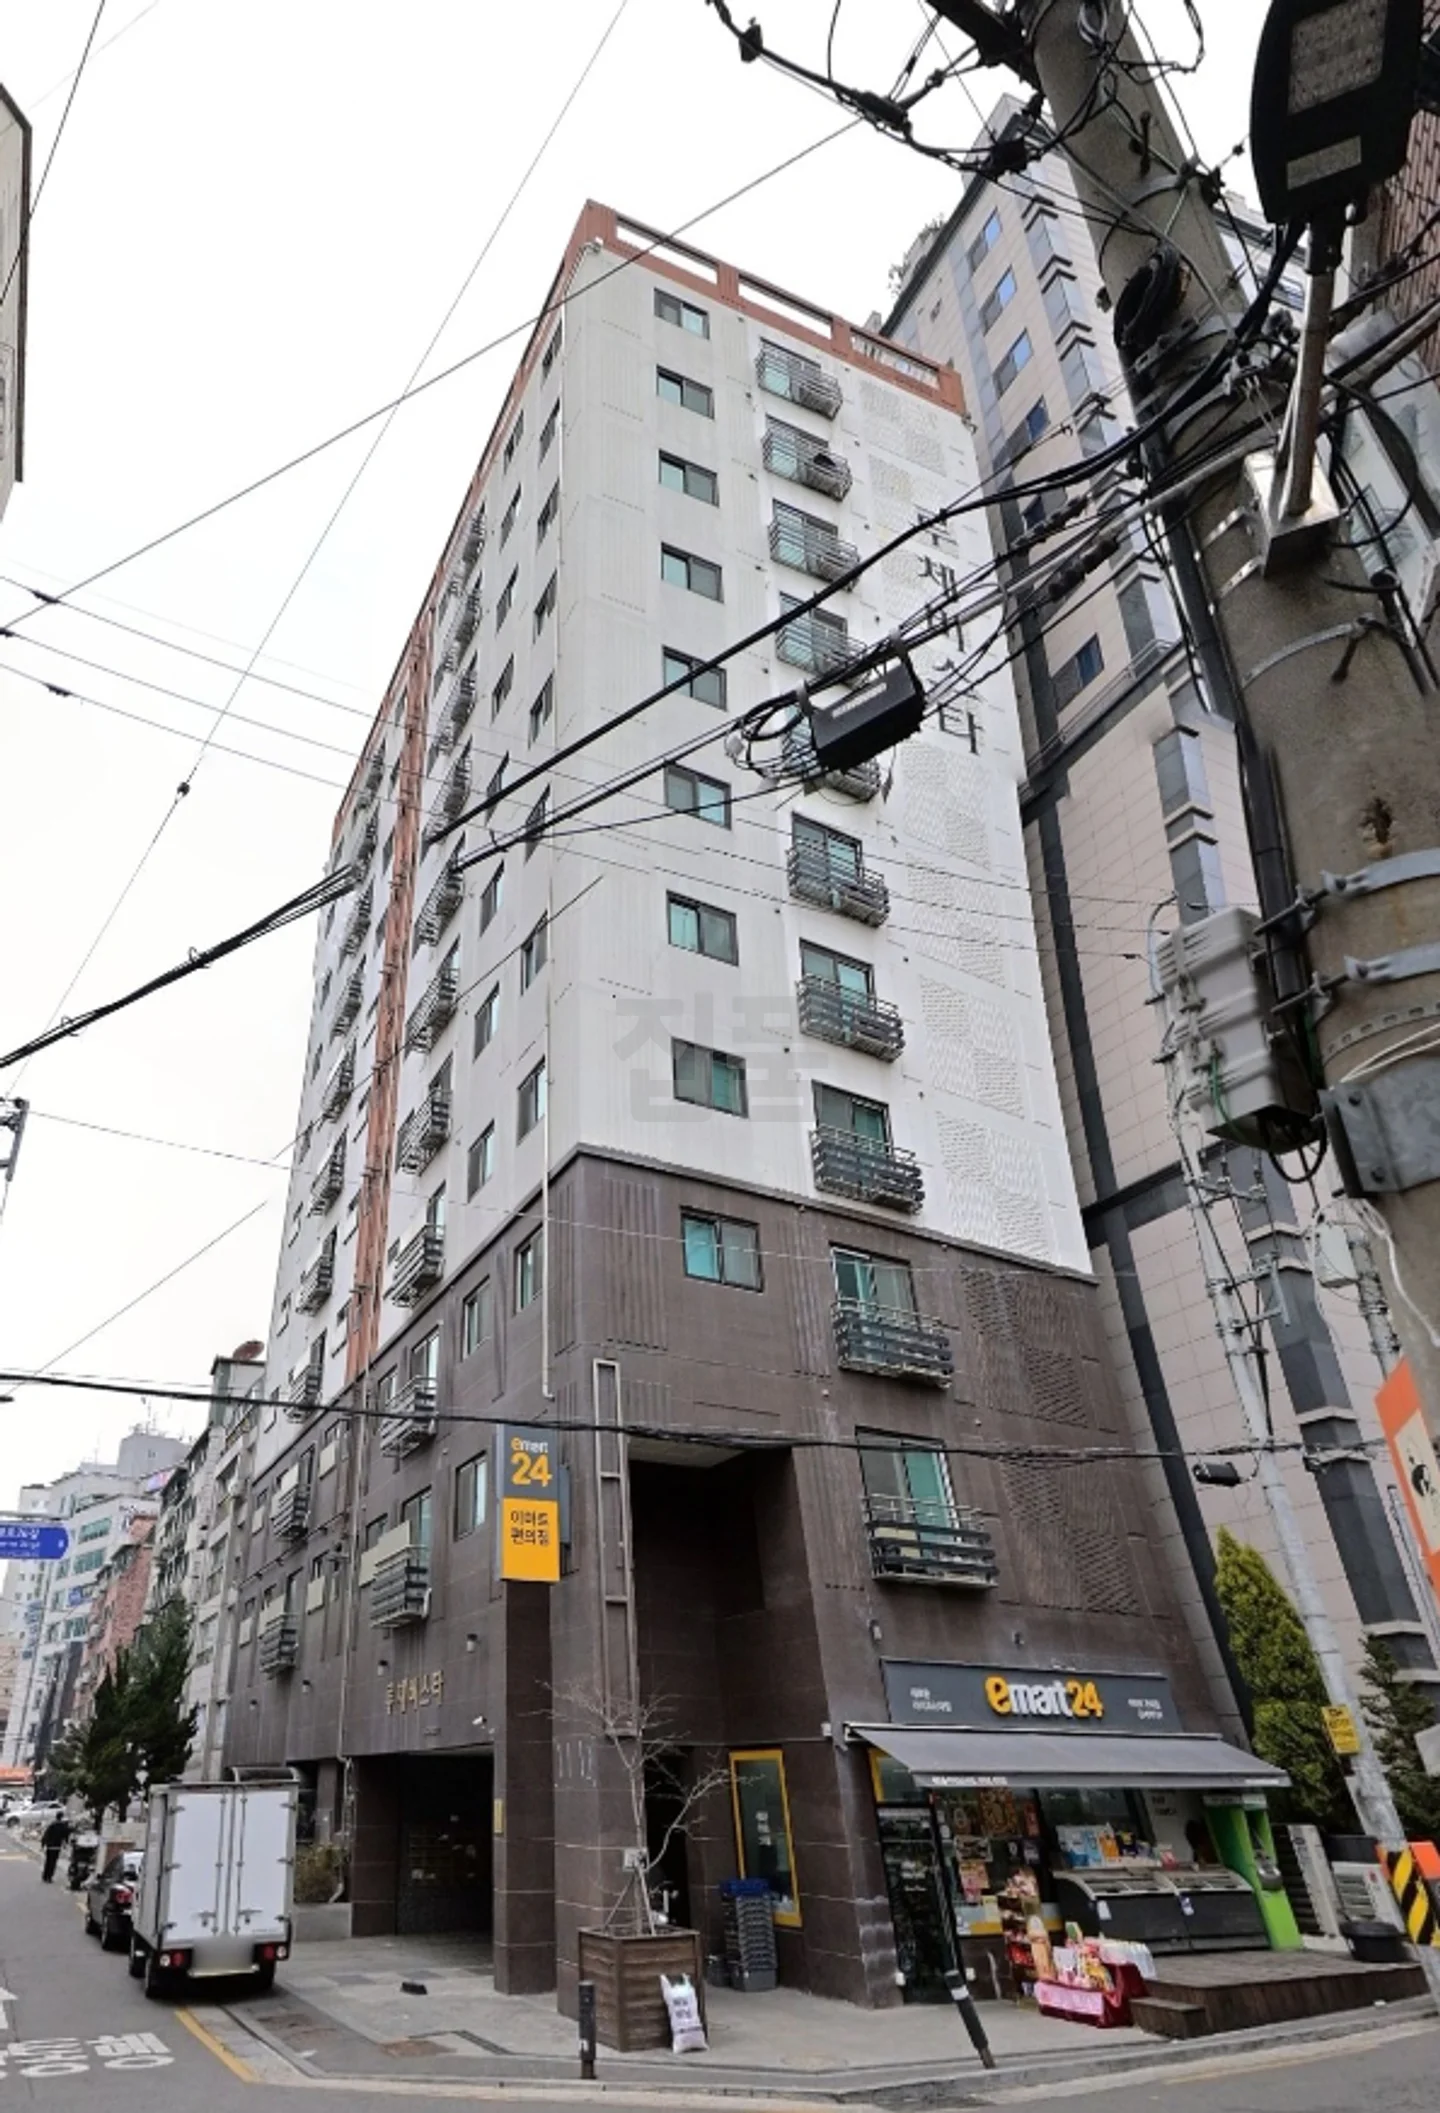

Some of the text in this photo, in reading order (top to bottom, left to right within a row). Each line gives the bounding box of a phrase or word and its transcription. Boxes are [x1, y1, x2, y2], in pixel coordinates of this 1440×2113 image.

[510, 1452, 553, 1487] 24
[510, 1510, 549, 1526] 이마트
[510, 1527, 549, 1546] 편의점
[984, 1676, 1103, 1719] emart24
